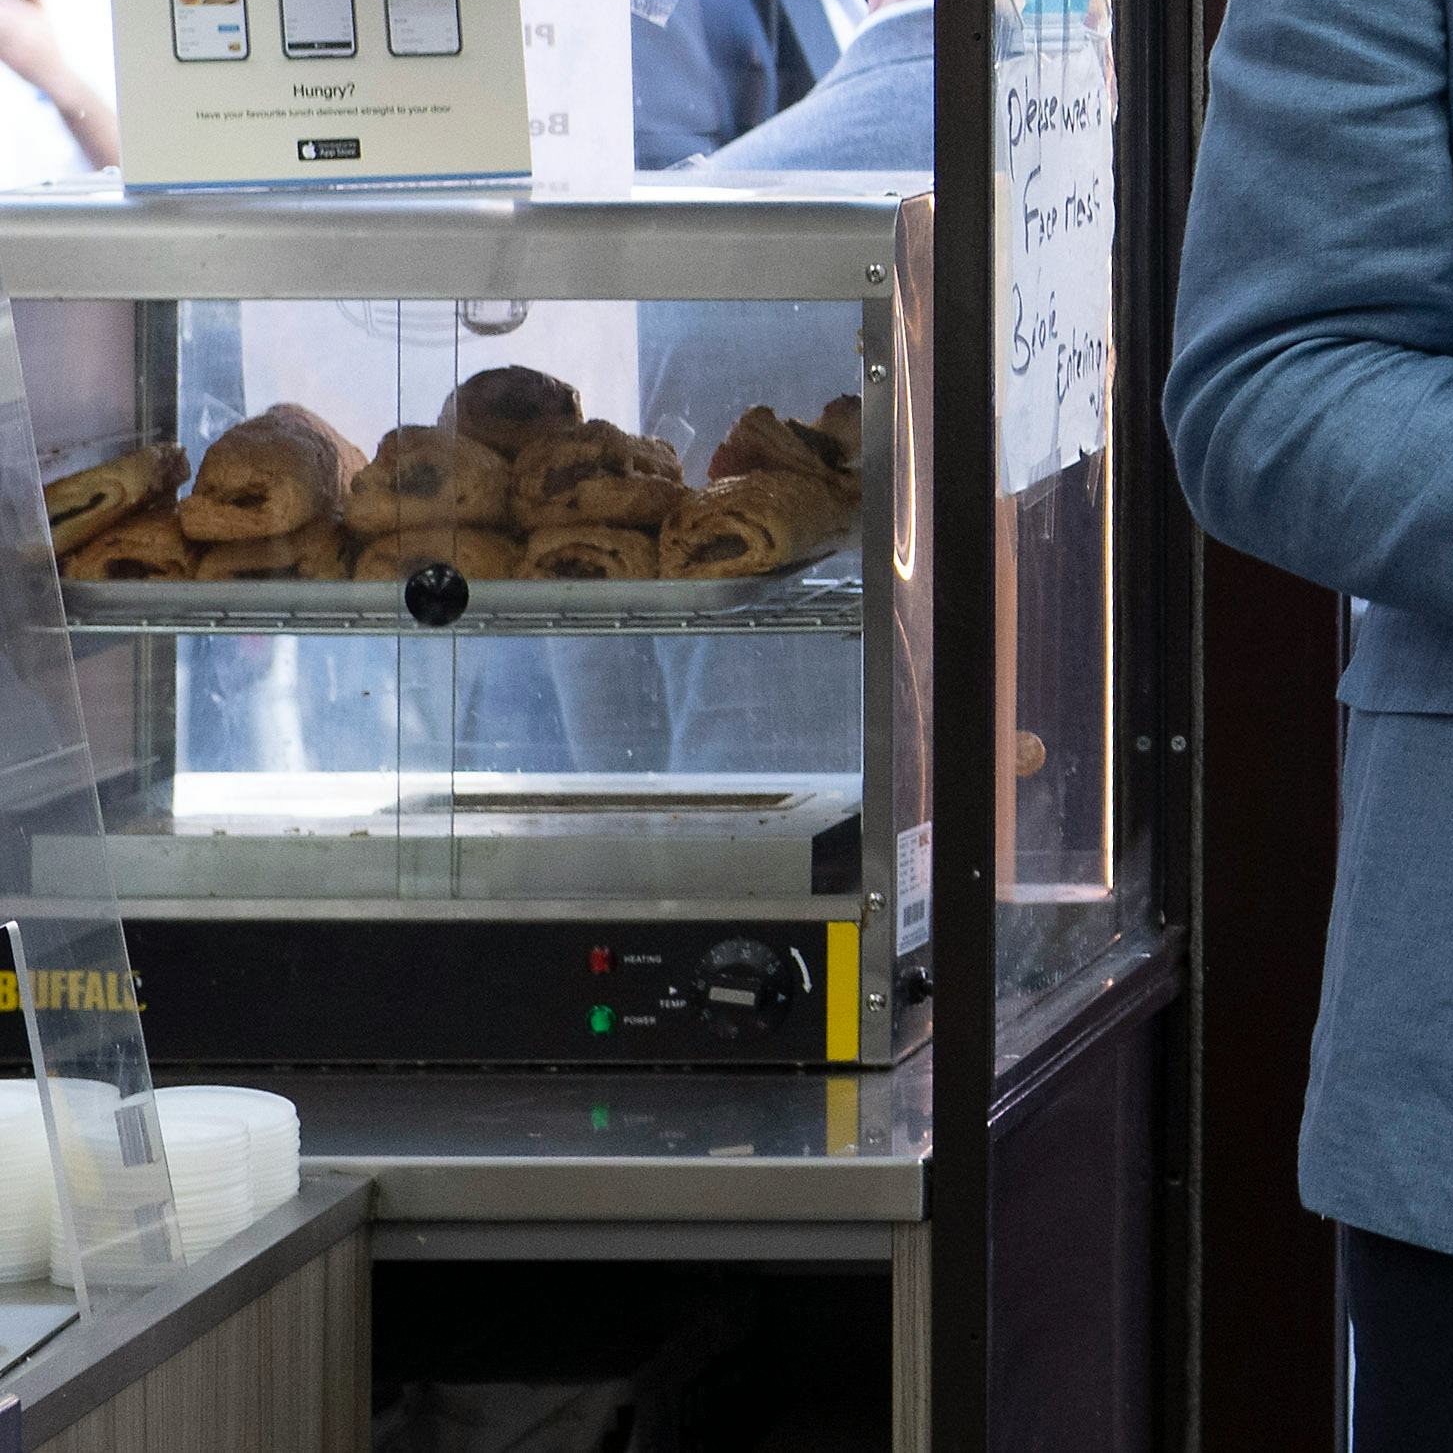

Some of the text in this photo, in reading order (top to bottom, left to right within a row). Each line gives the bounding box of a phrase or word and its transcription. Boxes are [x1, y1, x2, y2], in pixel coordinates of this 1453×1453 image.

[293, 83, 356, 99] Hungry?
[623, 954, 662, 964] HEATING
[659, 999, 688, 1009] TEMP
[623, 1015, 657, 1026] POWER
